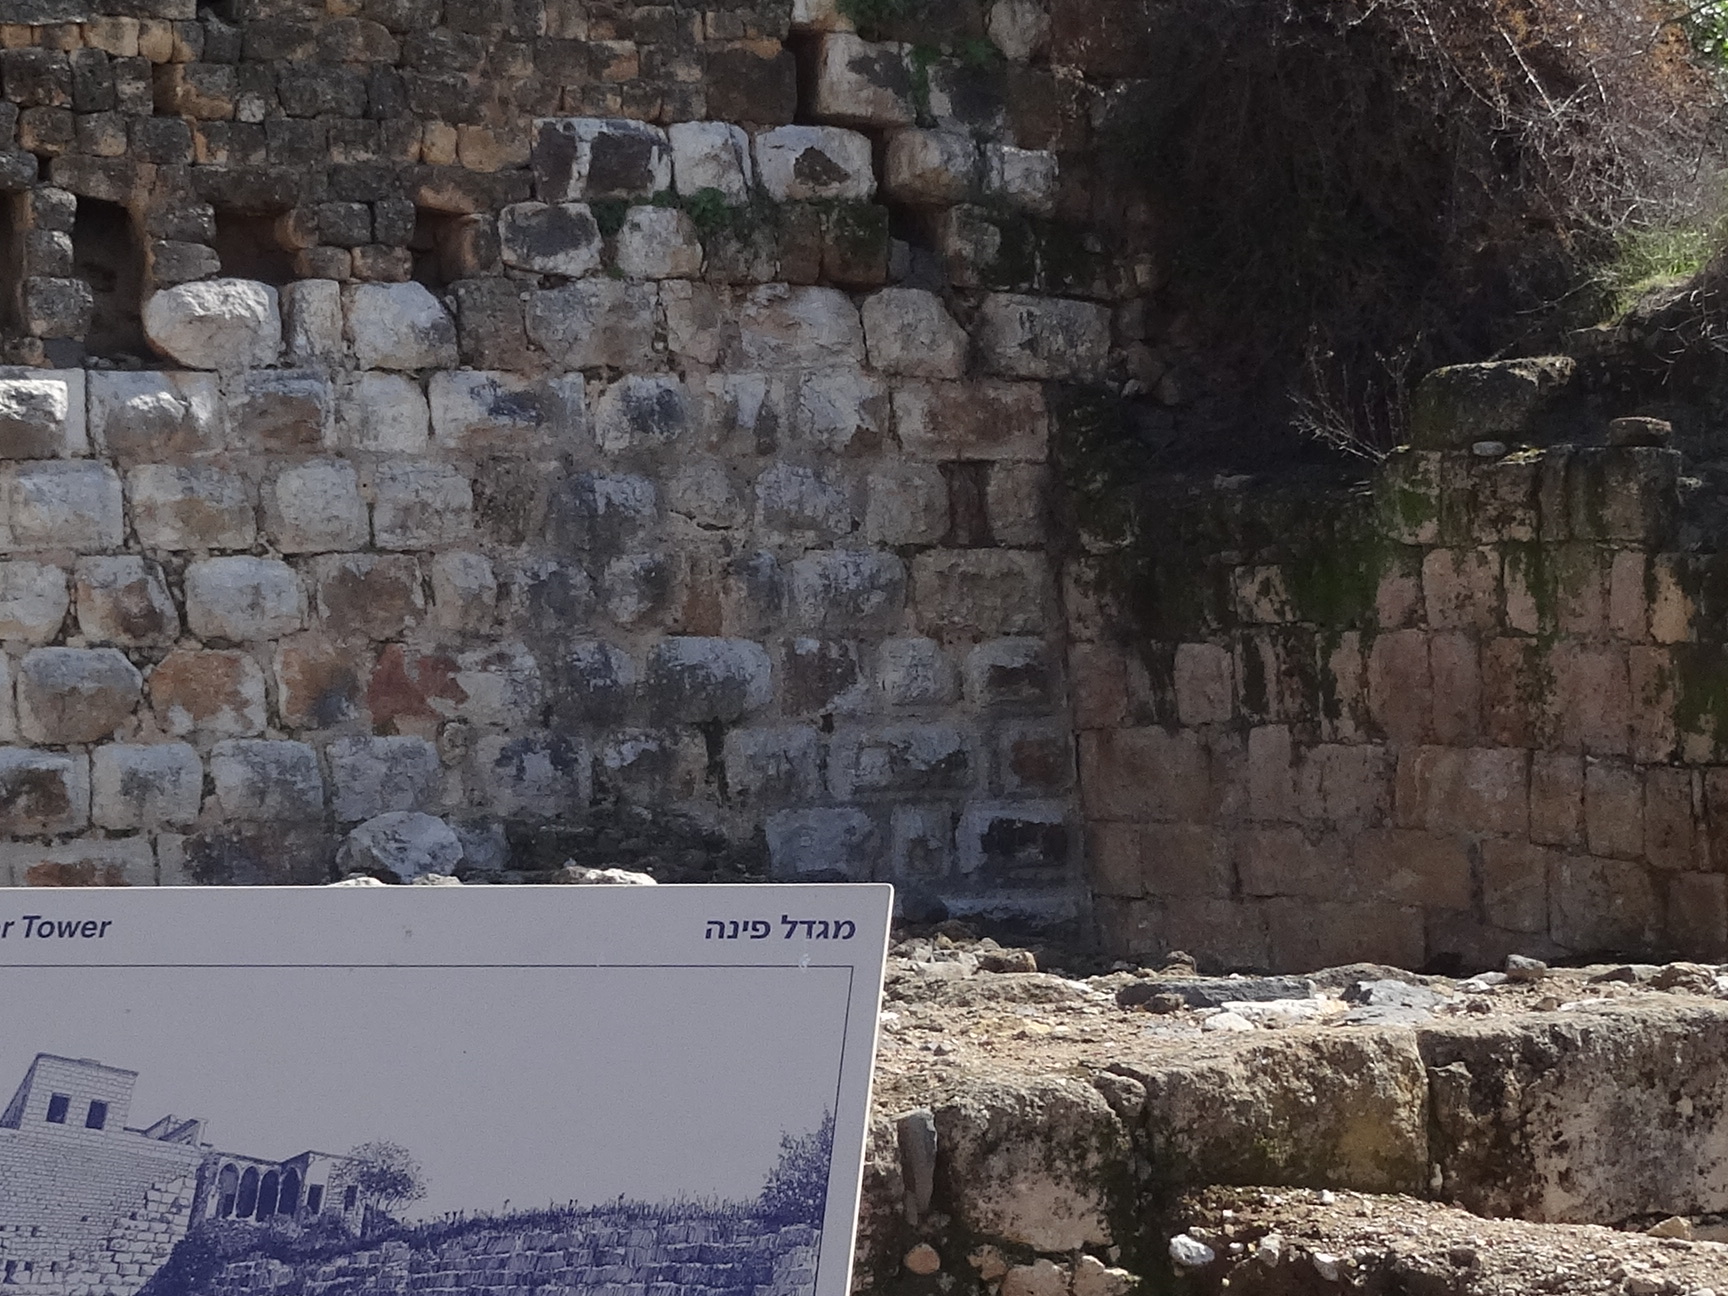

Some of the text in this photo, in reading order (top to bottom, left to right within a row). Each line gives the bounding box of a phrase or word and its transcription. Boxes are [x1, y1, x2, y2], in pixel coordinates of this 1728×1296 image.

[20, 914, 113, 939] Tower
[703, 913, 856, 940] מגדל פינה
